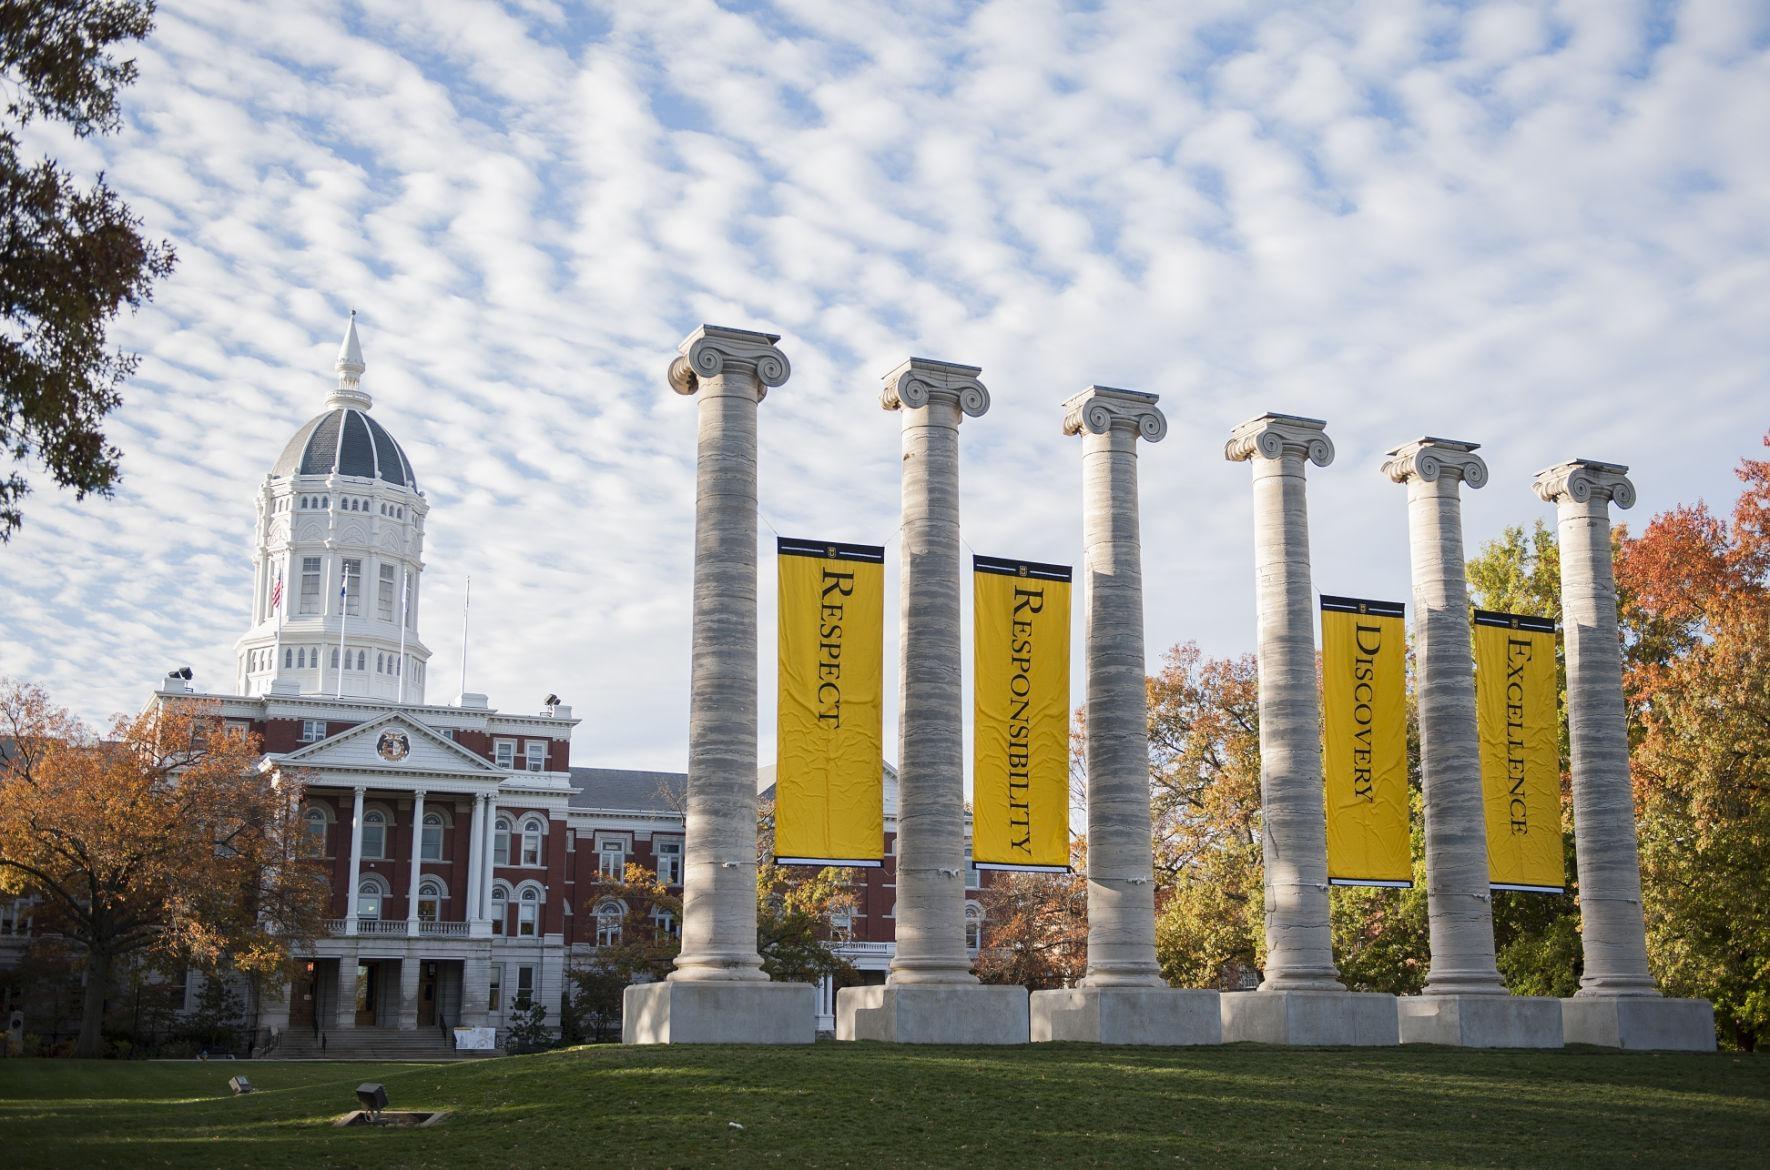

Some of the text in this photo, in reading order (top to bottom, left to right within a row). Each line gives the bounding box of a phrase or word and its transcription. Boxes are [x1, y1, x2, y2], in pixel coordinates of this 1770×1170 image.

[817, 567, 855, 730] RESPECT
[1008, 585, 1044, 856] RESPONSIBILITY
[1353, 622, 1382, 804] DISCOVERY
[1506, 635, 1533, 836] EXCELLENCE
